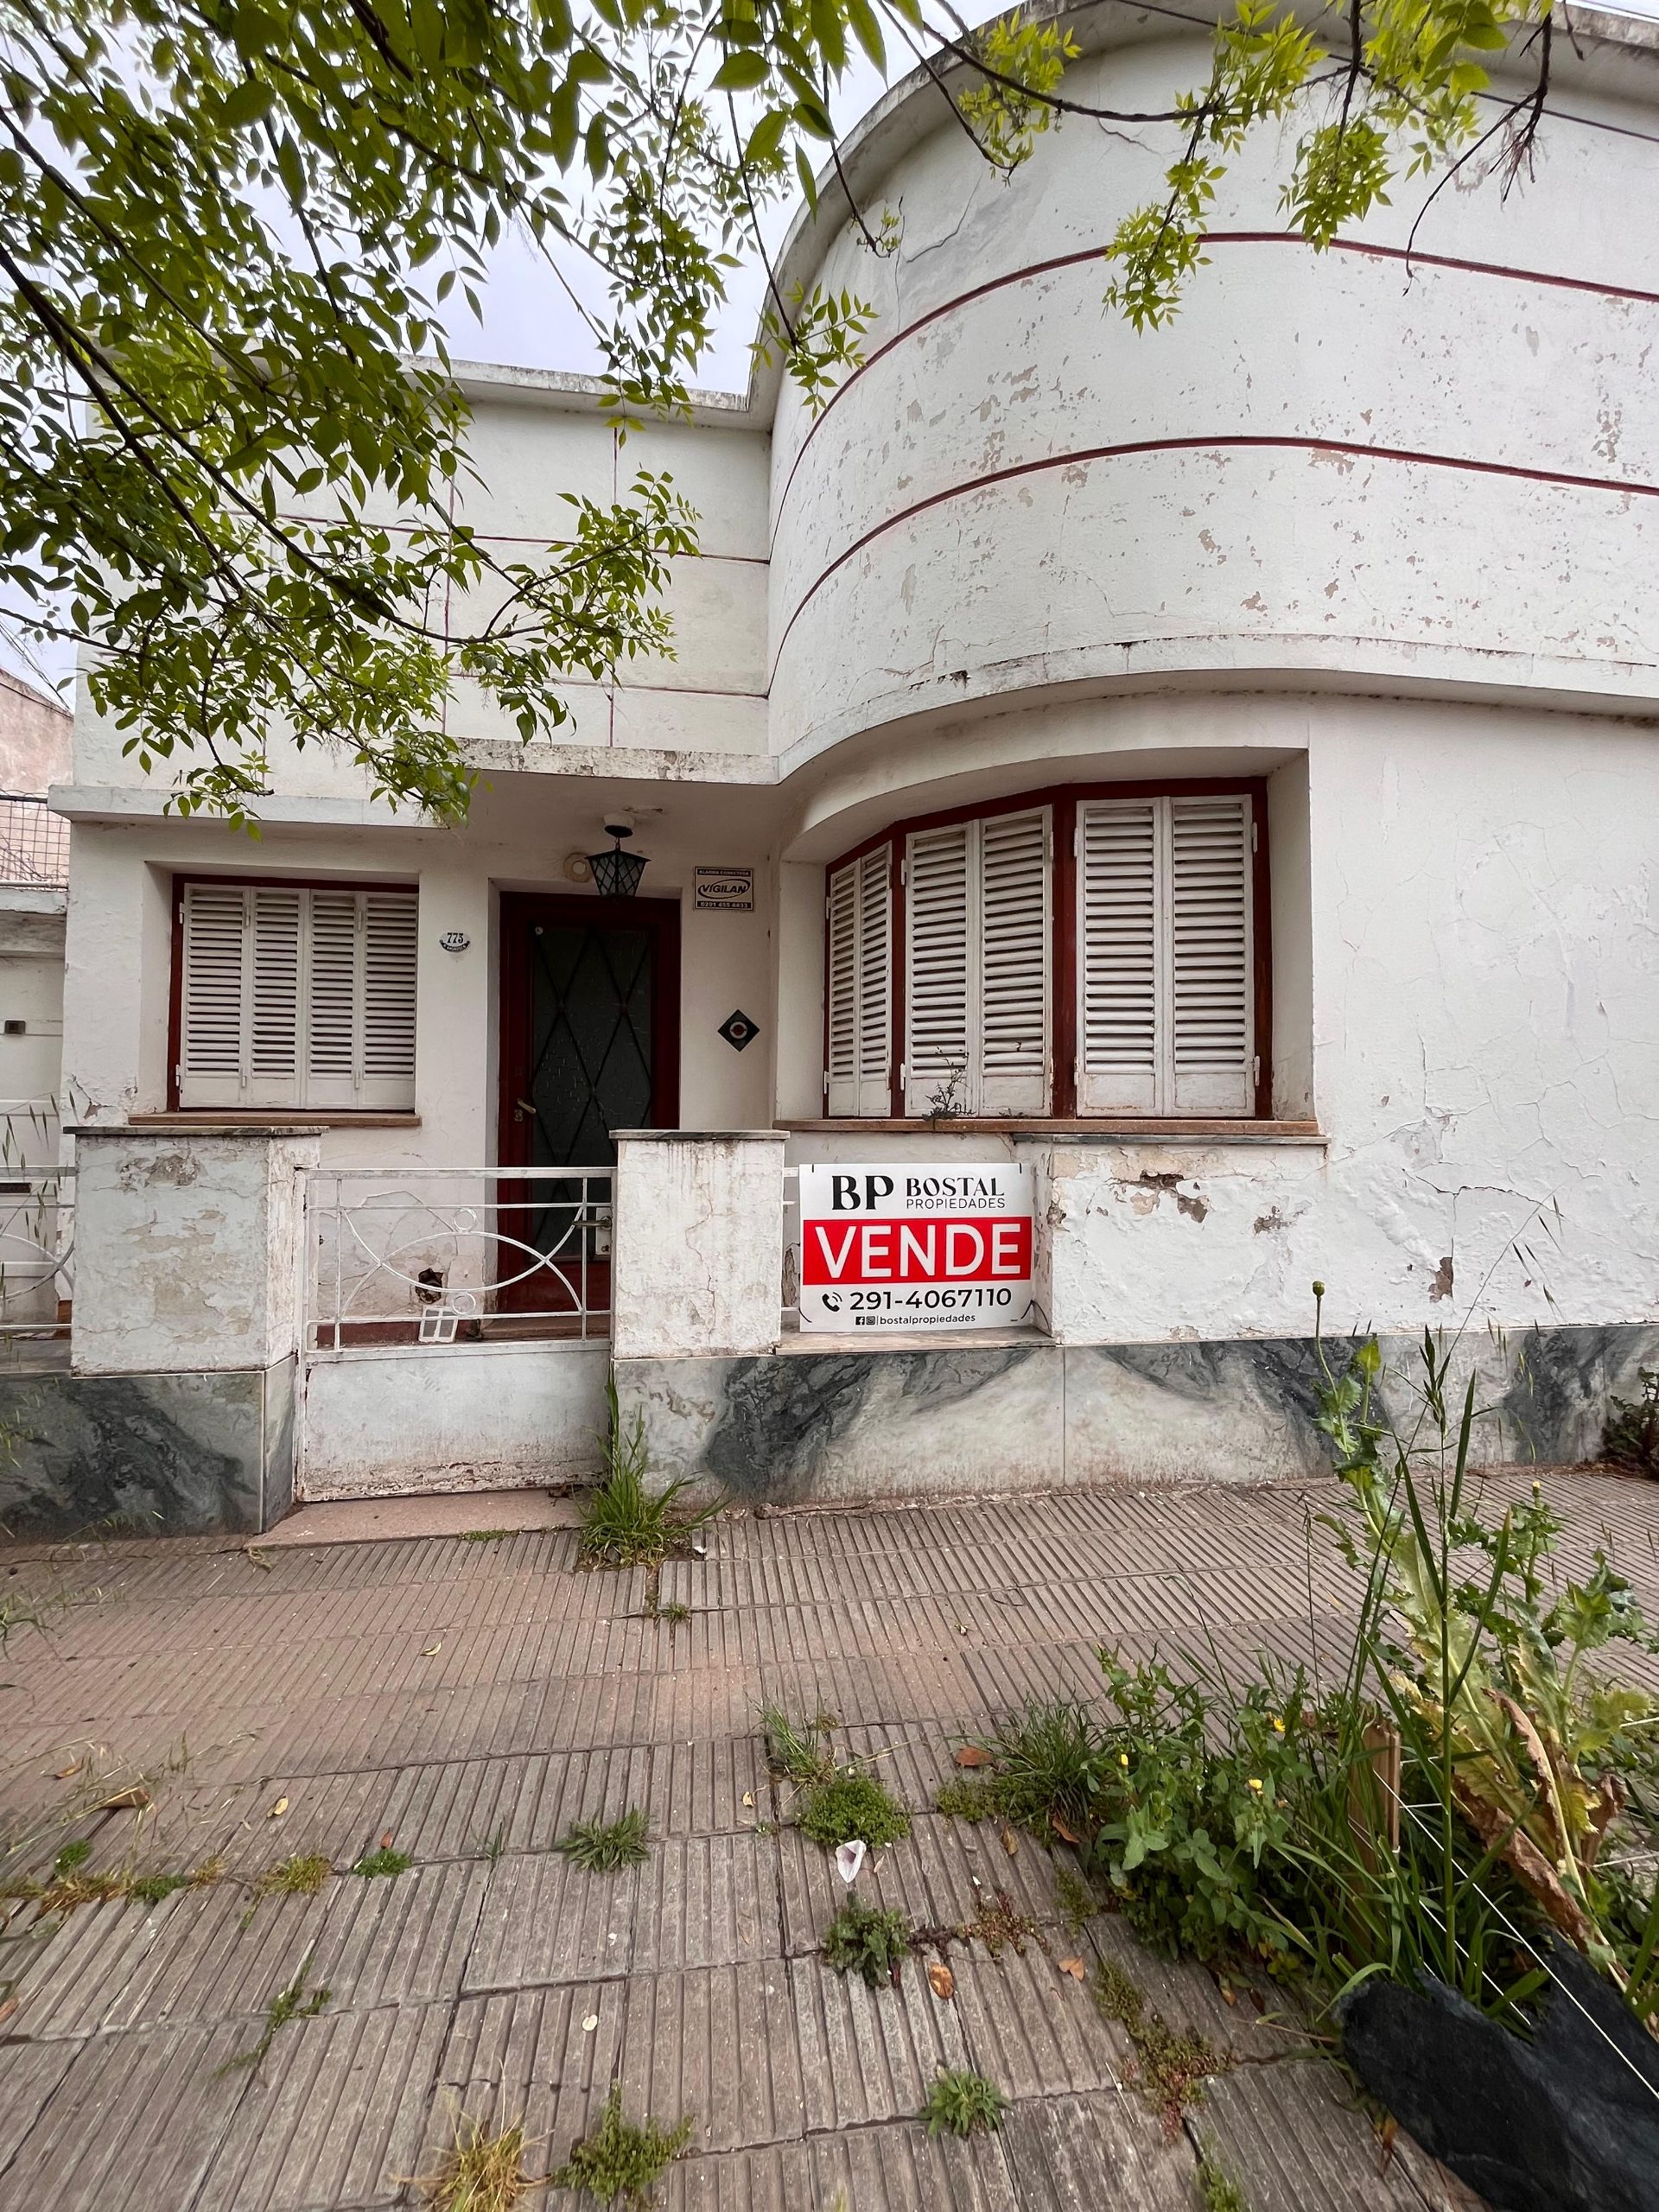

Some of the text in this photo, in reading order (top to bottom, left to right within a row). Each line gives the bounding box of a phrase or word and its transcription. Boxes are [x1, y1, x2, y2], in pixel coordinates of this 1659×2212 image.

[702, 884, 746, 893] VIGILAN
[448, 932, 463, 944] 773
[831, 1175, 1005, 1211] BP BOSTAL
[906, 1198, 1006, 1210] PROPIEDADES
[815, 1223, 1021, 1279] VENDE
[849, 1287, 1012, 1310] 291-4067110
[880, 1313, 976, 1325] bostalpropiedades
